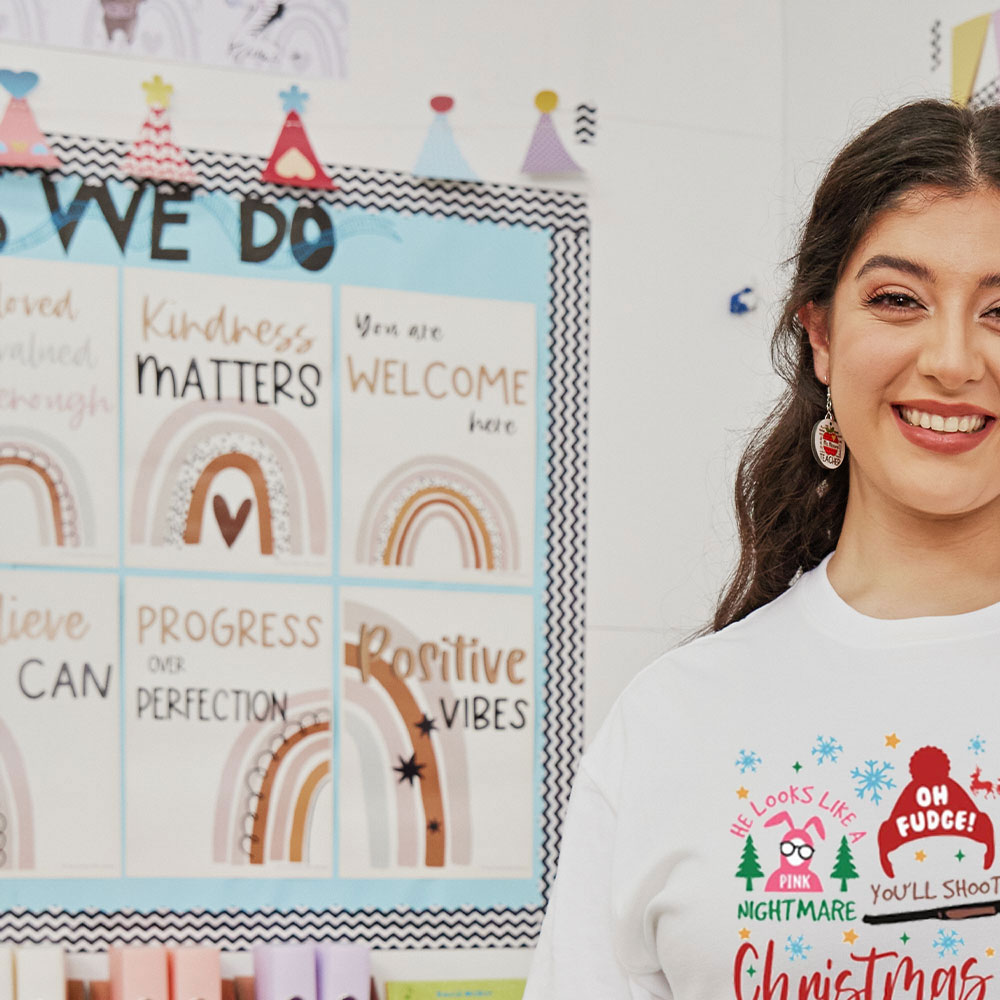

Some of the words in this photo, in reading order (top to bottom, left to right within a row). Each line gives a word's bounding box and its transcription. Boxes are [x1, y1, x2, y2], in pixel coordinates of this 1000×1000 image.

[38, 177, 194, 262] WE
[240, 196, 336, 272] DO
[141, 297, 316, 355] Kindness
[355, 312, 399, 341] You
[408, 325, 444, 343] are
[137, 354, 321, 408] MATTERS
[347, 355, 529, 406] WELCOME
[469, 410, 517, 436] here
[138, 605, 322, 649] PROGRESS
[147, 654, 186, 675] OVER
[357, 622, 527, 684] Positive
[18, 656, 113, 700] CAN
[137, 686, 288, 723] PERFECTION
[440, 695, 530, 731] VIBES
[915, 784, 949, 807] OH
[730, 813, 754, 839] HE
[751, 785, 814, 818] LOOKS
[818, 791, 858, 828] LIKE
[849, 829, 868, 844] A
[896, 808, 977, 838] FUDGE!
[779, 874, 811, 890] PINK
[870, 881, 937, 905] YOU'LL
[737, 899, 857, 922] NIGHTMARE
